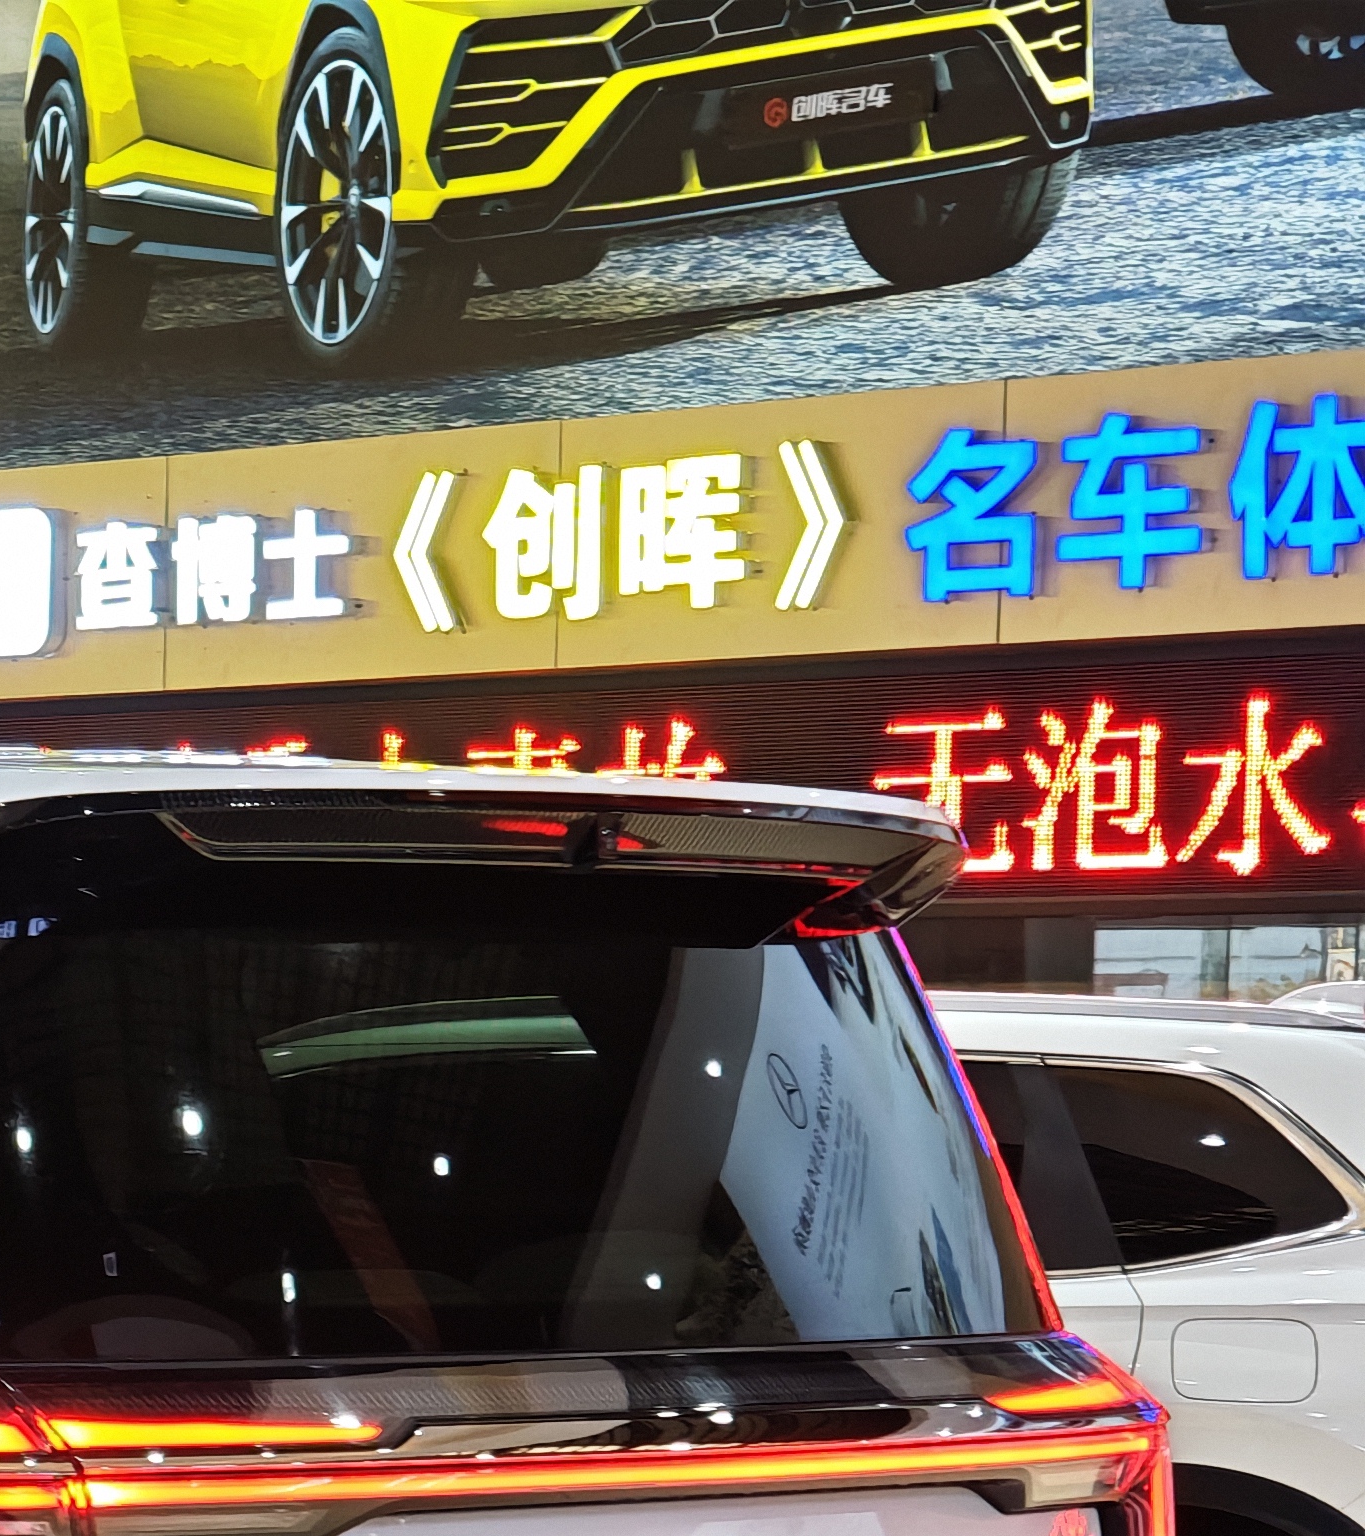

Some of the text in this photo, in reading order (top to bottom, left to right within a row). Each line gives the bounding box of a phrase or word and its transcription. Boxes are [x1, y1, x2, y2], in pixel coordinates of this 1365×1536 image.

[75, 509, 351, 630] 查博士
[905, 393, 1365, 603] 名车体
[872, 690, 1365, 878] 无泡水
